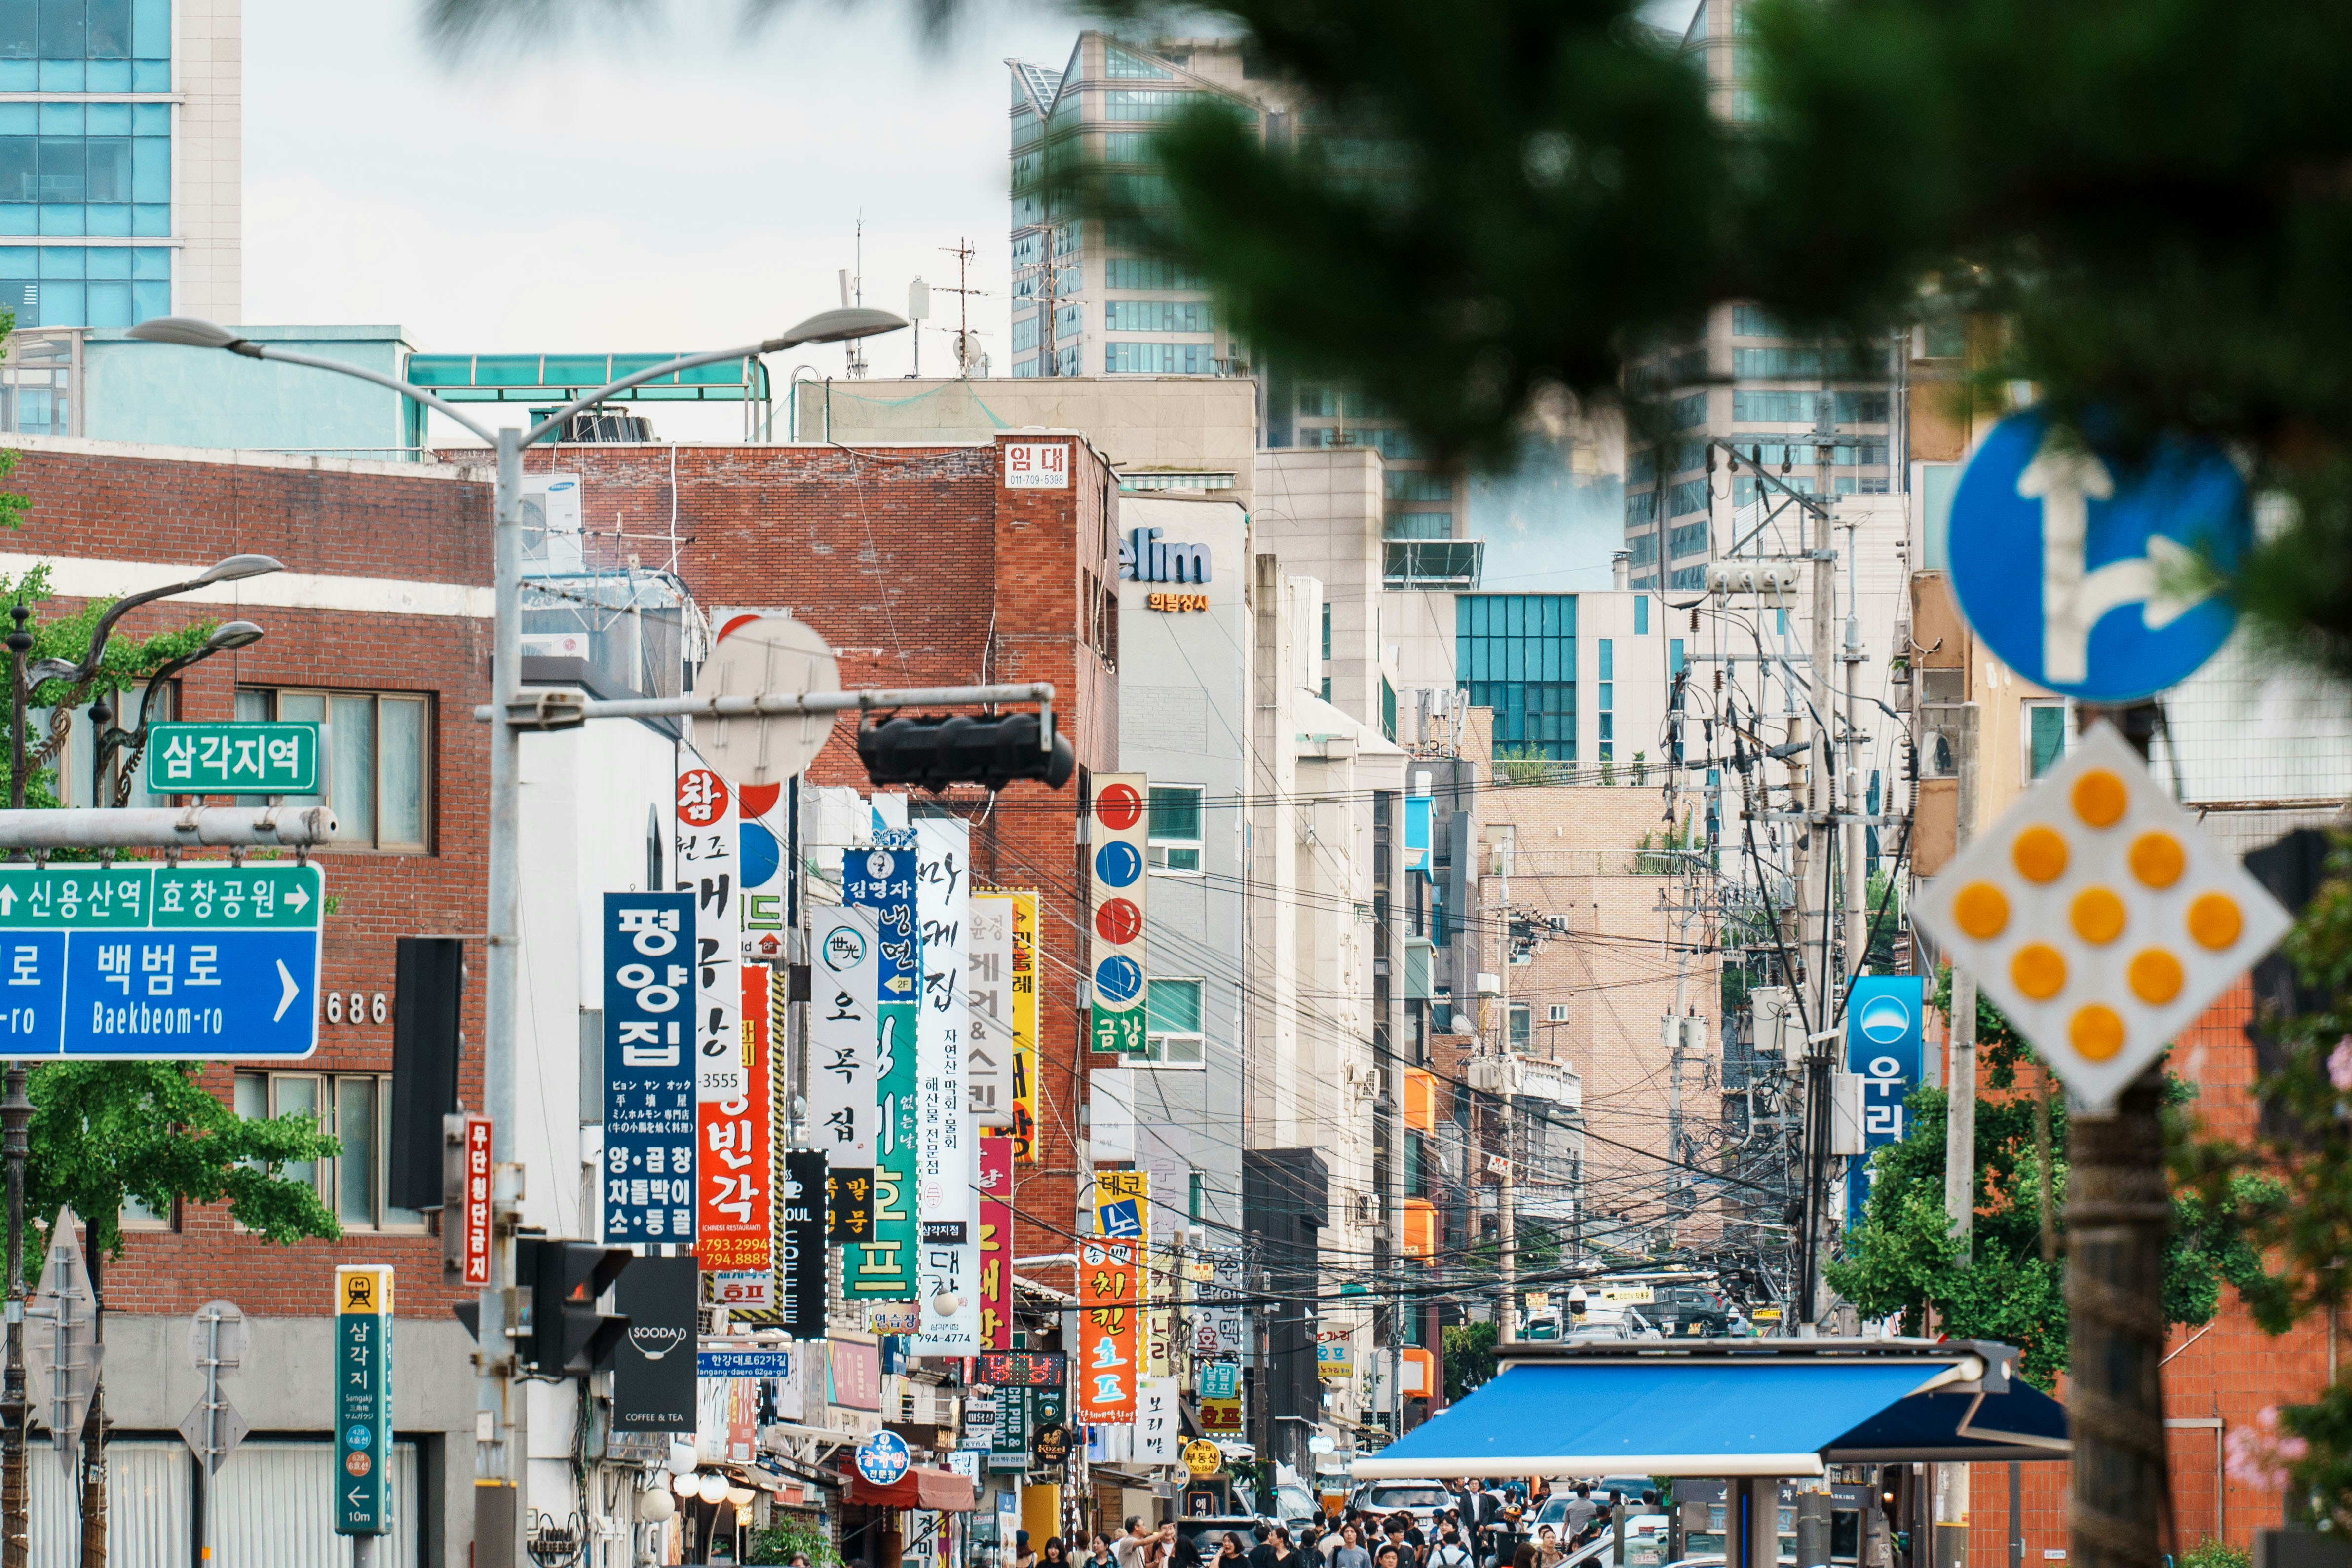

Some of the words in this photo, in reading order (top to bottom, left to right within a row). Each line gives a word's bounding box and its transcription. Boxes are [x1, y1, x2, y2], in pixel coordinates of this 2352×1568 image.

[1010, 475, 1064, 485] 011-709-5398
[1149, 593, 1210, 613] 희림상사
[162, 735, 299, 780] 삼각지역
[678, 771, 721, 821] 참
[677, 835, 729, 860] 원조
[27, 880, 141, 919] 신용산역
[158, 880, 275, 919] 효창공원
[848, 879, 912, 899] 김명자
[879, 903, 914, 971] 냉면
[829, 936, 860, 960] 世光
[97, 945, 222, 996] 백범로
[616, 909, 688, 1067] 평양집
[897, 980, 909, 989] 2F
[969, 953, 998, 1018] 헤어
[92, 1002, 222, 1035] Baekbeom-ro
[326, 992, 387, 1025] 686
[1097, 1015, 1141, 1048] 금강
[944, 1029, 958, 1075] 자연산
[823, 990, 861, 1143] 오목집
[968, 1047, 998, 1114] 스킨
[925, 1077, 939, 1124] 해산물
[944, 1079, 958, 1149] 막회·물회
[925, 1128, 939, 1175] 전문점
[608, 1178, 690, 1205] 차돌박이
[471, 1126, 488, 1280] 무단횡단금지
[702, 1224, 725, 1232] (CHINESE
[726, 1224, 761, 1232] RESTAURANT)
[854, 1164, 907, 1291] 호프
[922, 1225, 959, 1237] 삼각지점
[706, 1253, 769, 1266] 794.8885
[723, 1284, 765, 1303] 호프
[1090, 1270, 1126, 1336] 치킨
[874, 1313, 916, 1329] 연습장
[349, 1322, 370, 1390] 삼각지
[711, 1354, 786, 1367] 한강대로62가길
[1317, 1344, 1346, 1361] 호프
[755, 1368, 786, 1377] 62ga-gil
[1091, 1336, 1128, 1404] 호프
[1206, 1367, 1231, 1382] 달달
[345, 1394, 373, 1403] Samgakji
[1205, 1382, 1230, 1394] 호프
[625, 1413, 655, 1422] COFFEE
[658, 1413, 665, 1422] &
[667, 1413, 683, 1422] TEA
[968, 1413, 993, 1423] 미용실
[1008, 1407, 1021, 1435] PUB
[1079, 1409, 1134, 1422] 단체예약환영
[1200, 1406, 1241, 1429] 호프
[349, 1436, 369, 1445] 4호선
[1008, 1439, 1021, 1448] &
[1037, 1444, 1066, 1454] Kozel
[348, 1462, 369, 1471] 6호선
[861, 1450, 907, 1469] 굴국밥
[951, 1454, 972, 1468] 국밥
[1186, 1452, 1217, 1464] 부동산
[869, 1469, 896, 1479] 전문점
[348, 1511, 370, 1522] 10m
